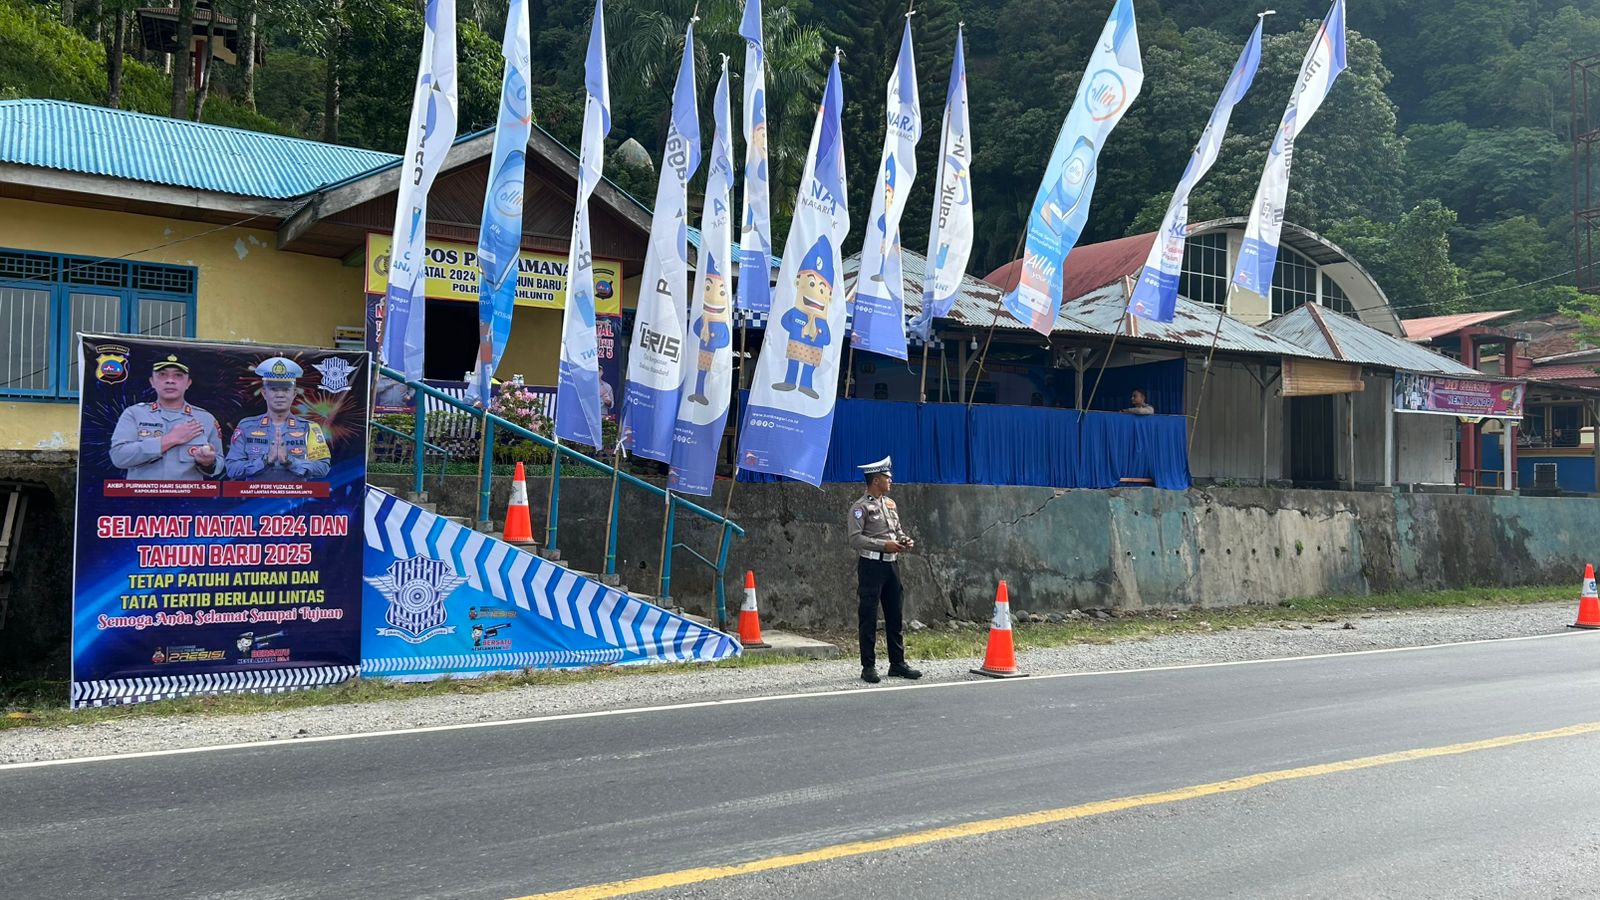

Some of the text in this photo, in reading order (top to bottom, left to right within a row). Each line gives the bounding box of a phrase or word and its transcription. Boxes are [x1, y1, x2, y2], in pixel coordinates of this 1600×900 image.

[1025, 254, 1048, 270] All
[450, 269, 476, 282] 2024
[537, 279, 561, 291] BARU
[98, 515, 348, 538] SELAMAT NATAL 2024 DAN
[137, 543, 311, 568] TAHUN BARU 2025
[129, 570, 318, 588] TETAP PATUHI ATURAN DAN
[121, 589, 325, 609] TATA TERTIB BERLALU LINTAS
[97, 606, 343, 630] Semoga Anda Selamat Sampai Tujuan
